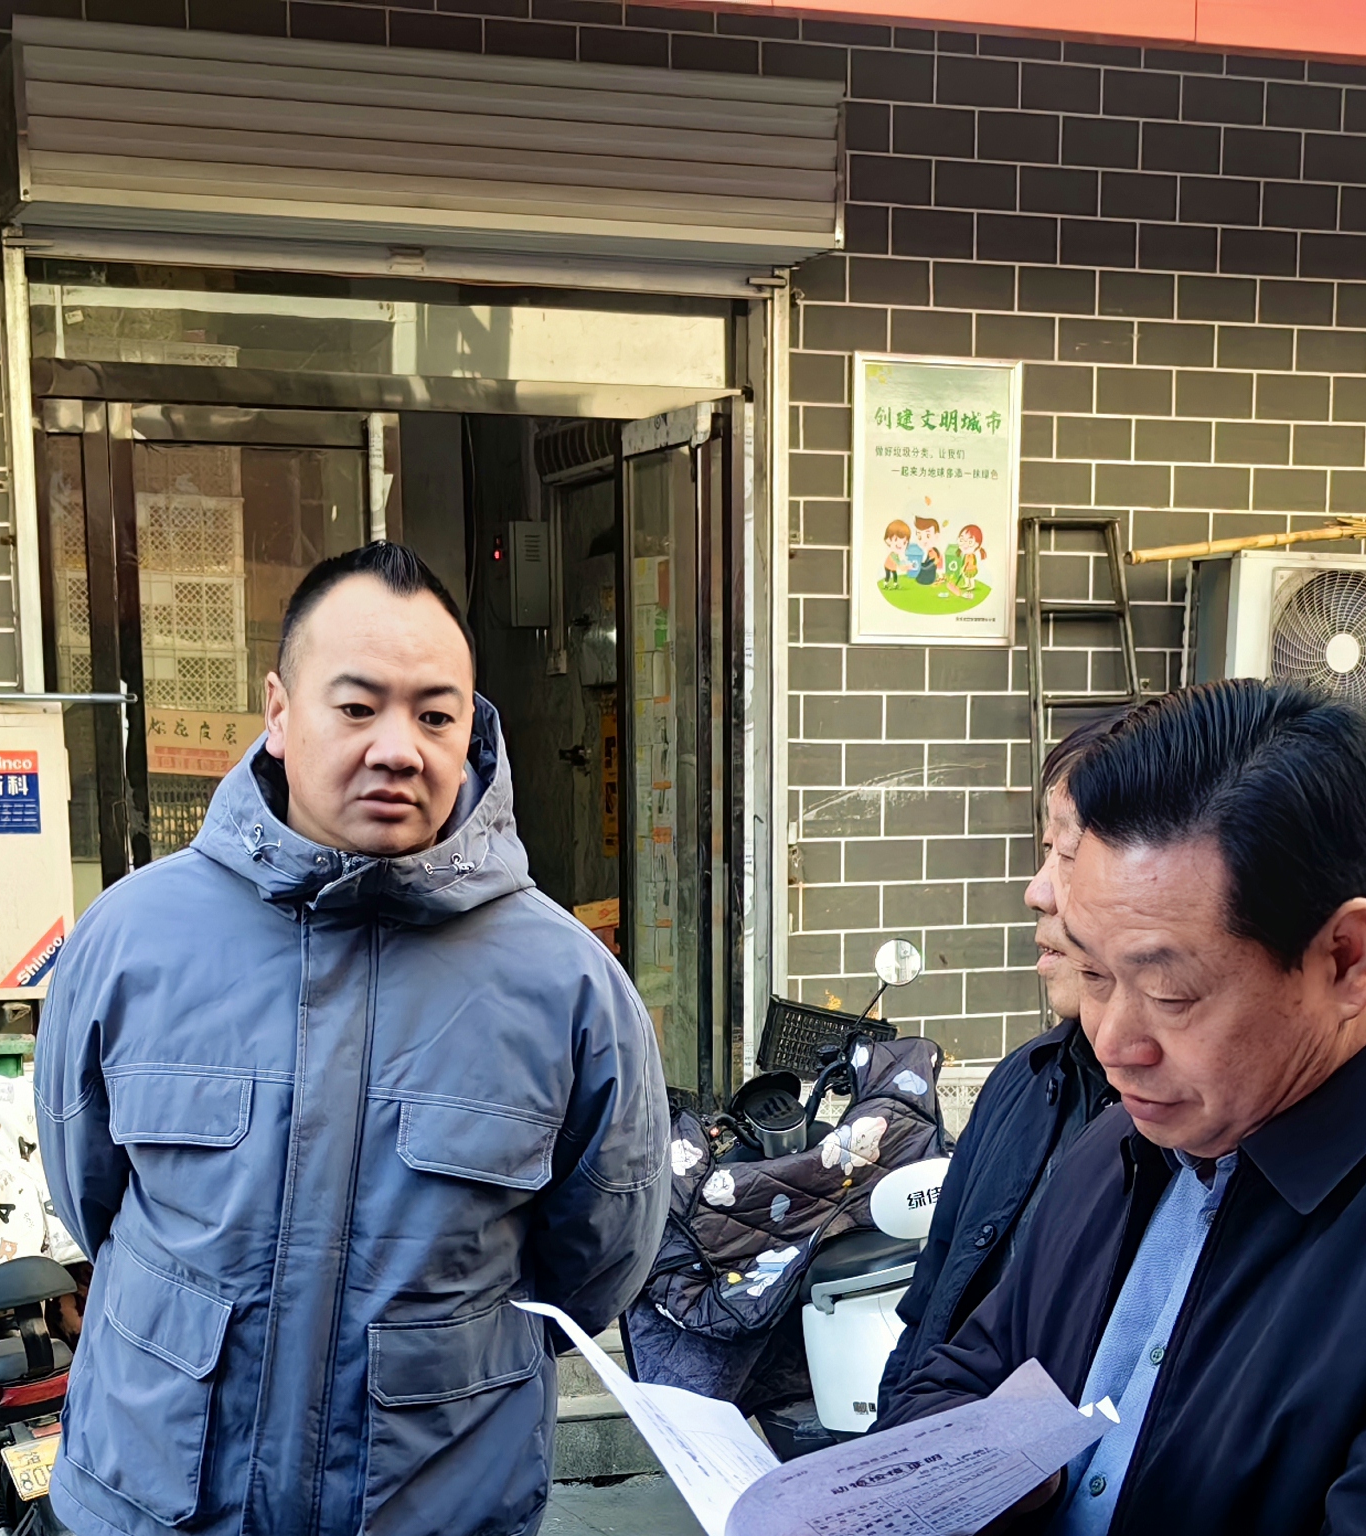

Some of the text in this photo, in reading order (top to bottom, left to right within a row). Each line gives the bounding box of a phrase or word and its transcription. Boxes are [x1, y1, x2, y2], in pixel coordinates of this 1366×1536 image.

[874, 406, 1002, 435] 创建文明城市
[16, 935, 63, 986] Shinco
